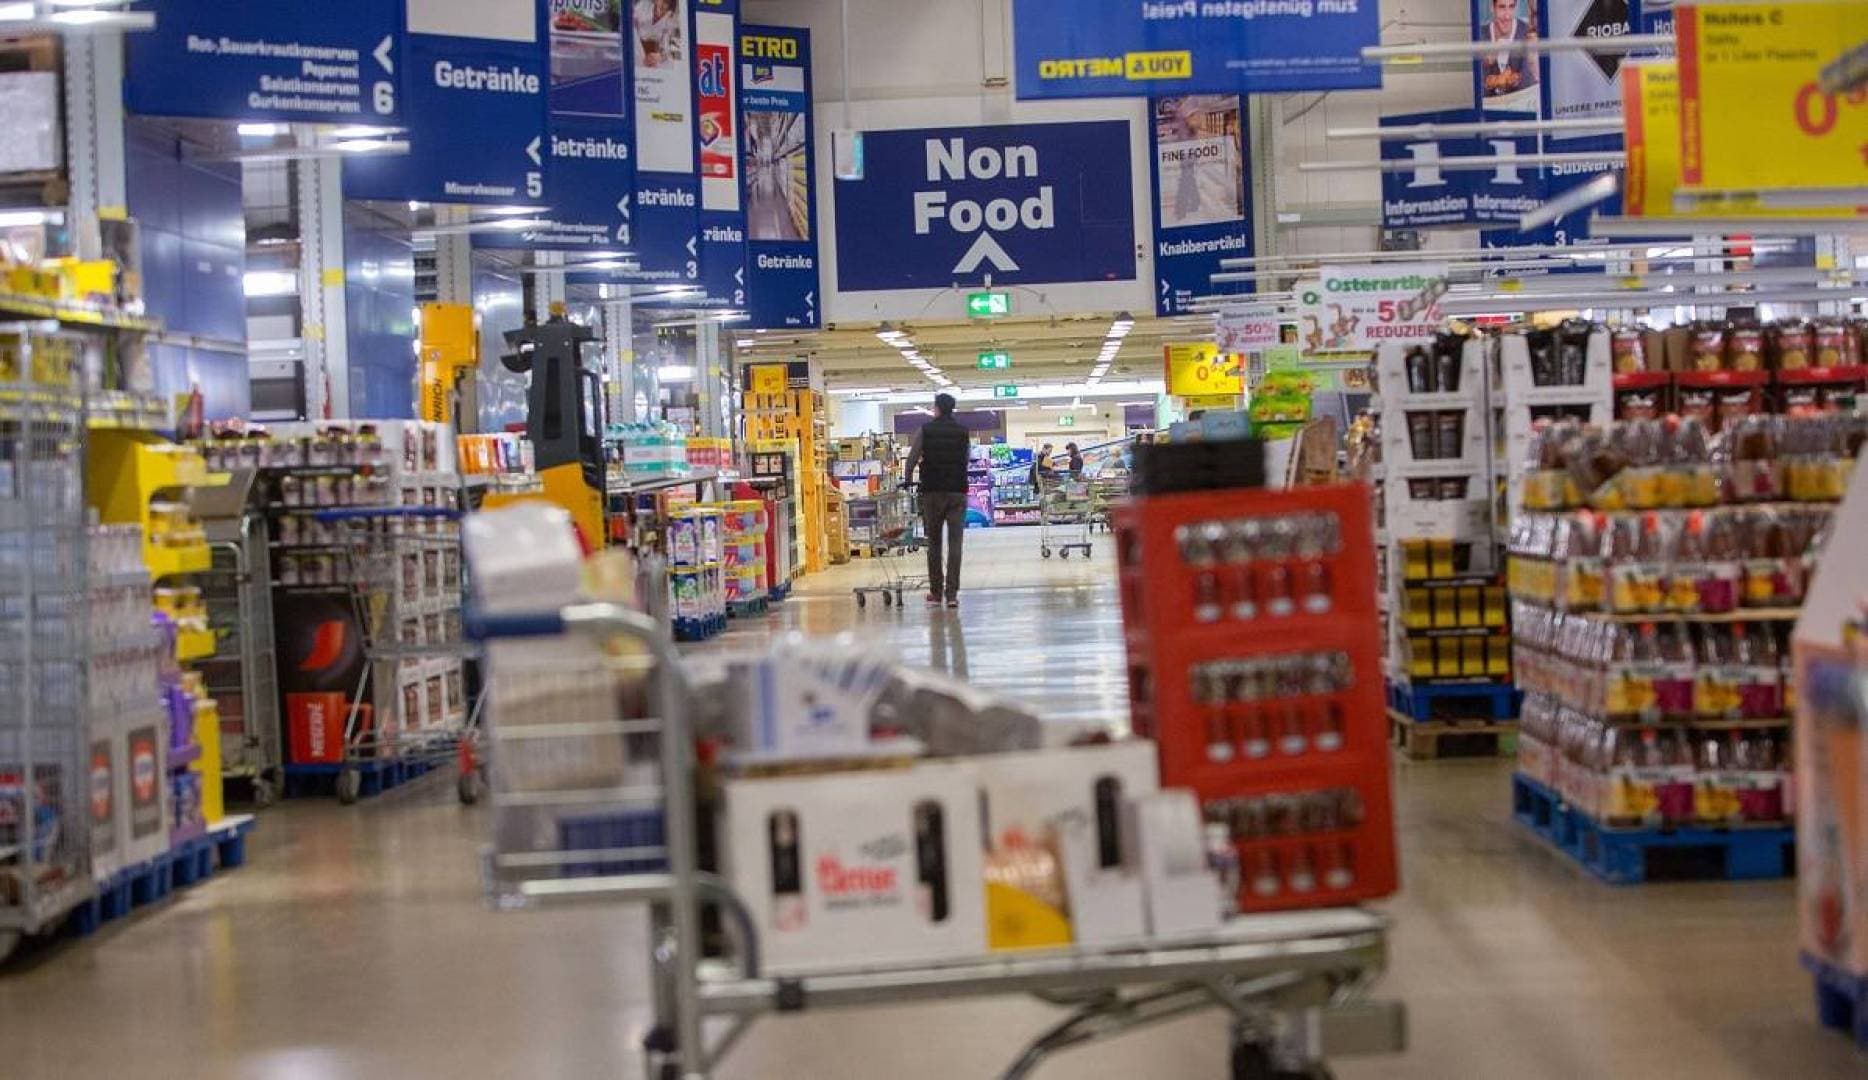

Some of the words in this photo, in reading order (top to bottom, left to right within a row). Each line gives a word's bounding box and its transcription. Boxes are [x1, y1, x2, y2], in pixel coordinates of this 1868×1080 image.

[740, 35, 797, 60] ETRO
[435, 60, 540, 93] Getränke
[699, 52, 725, 98] at
[372, 82, 394, 115] 6
[925, 138, 1039, 182] Non
[1161, 149, 1187, 163] FINE
[1189, 144, 1219, 159] FOOD
[526, 171, 543, 198] 5
[637, 188, 695, 208] etränke
[1385, 193, 1468, 217] Information
[914, 184, 1056, 234] Food
[617, 224, 630, 246] 4
[1159, 233, 1246, 257] Knabberartikel
[1554, 230, 1566, 247] 3
[686, 260, 697, 279] 3
[757, 254, 813, 270] Getränke
[1326, 274, 1442, 293] Osterartik
[734, 289, 745, 305] 2
[1162, 297, 1171, 313] 1
[806, 310, 815, 325] 1
[1365, 324, 1437, 338] REDUZIER
